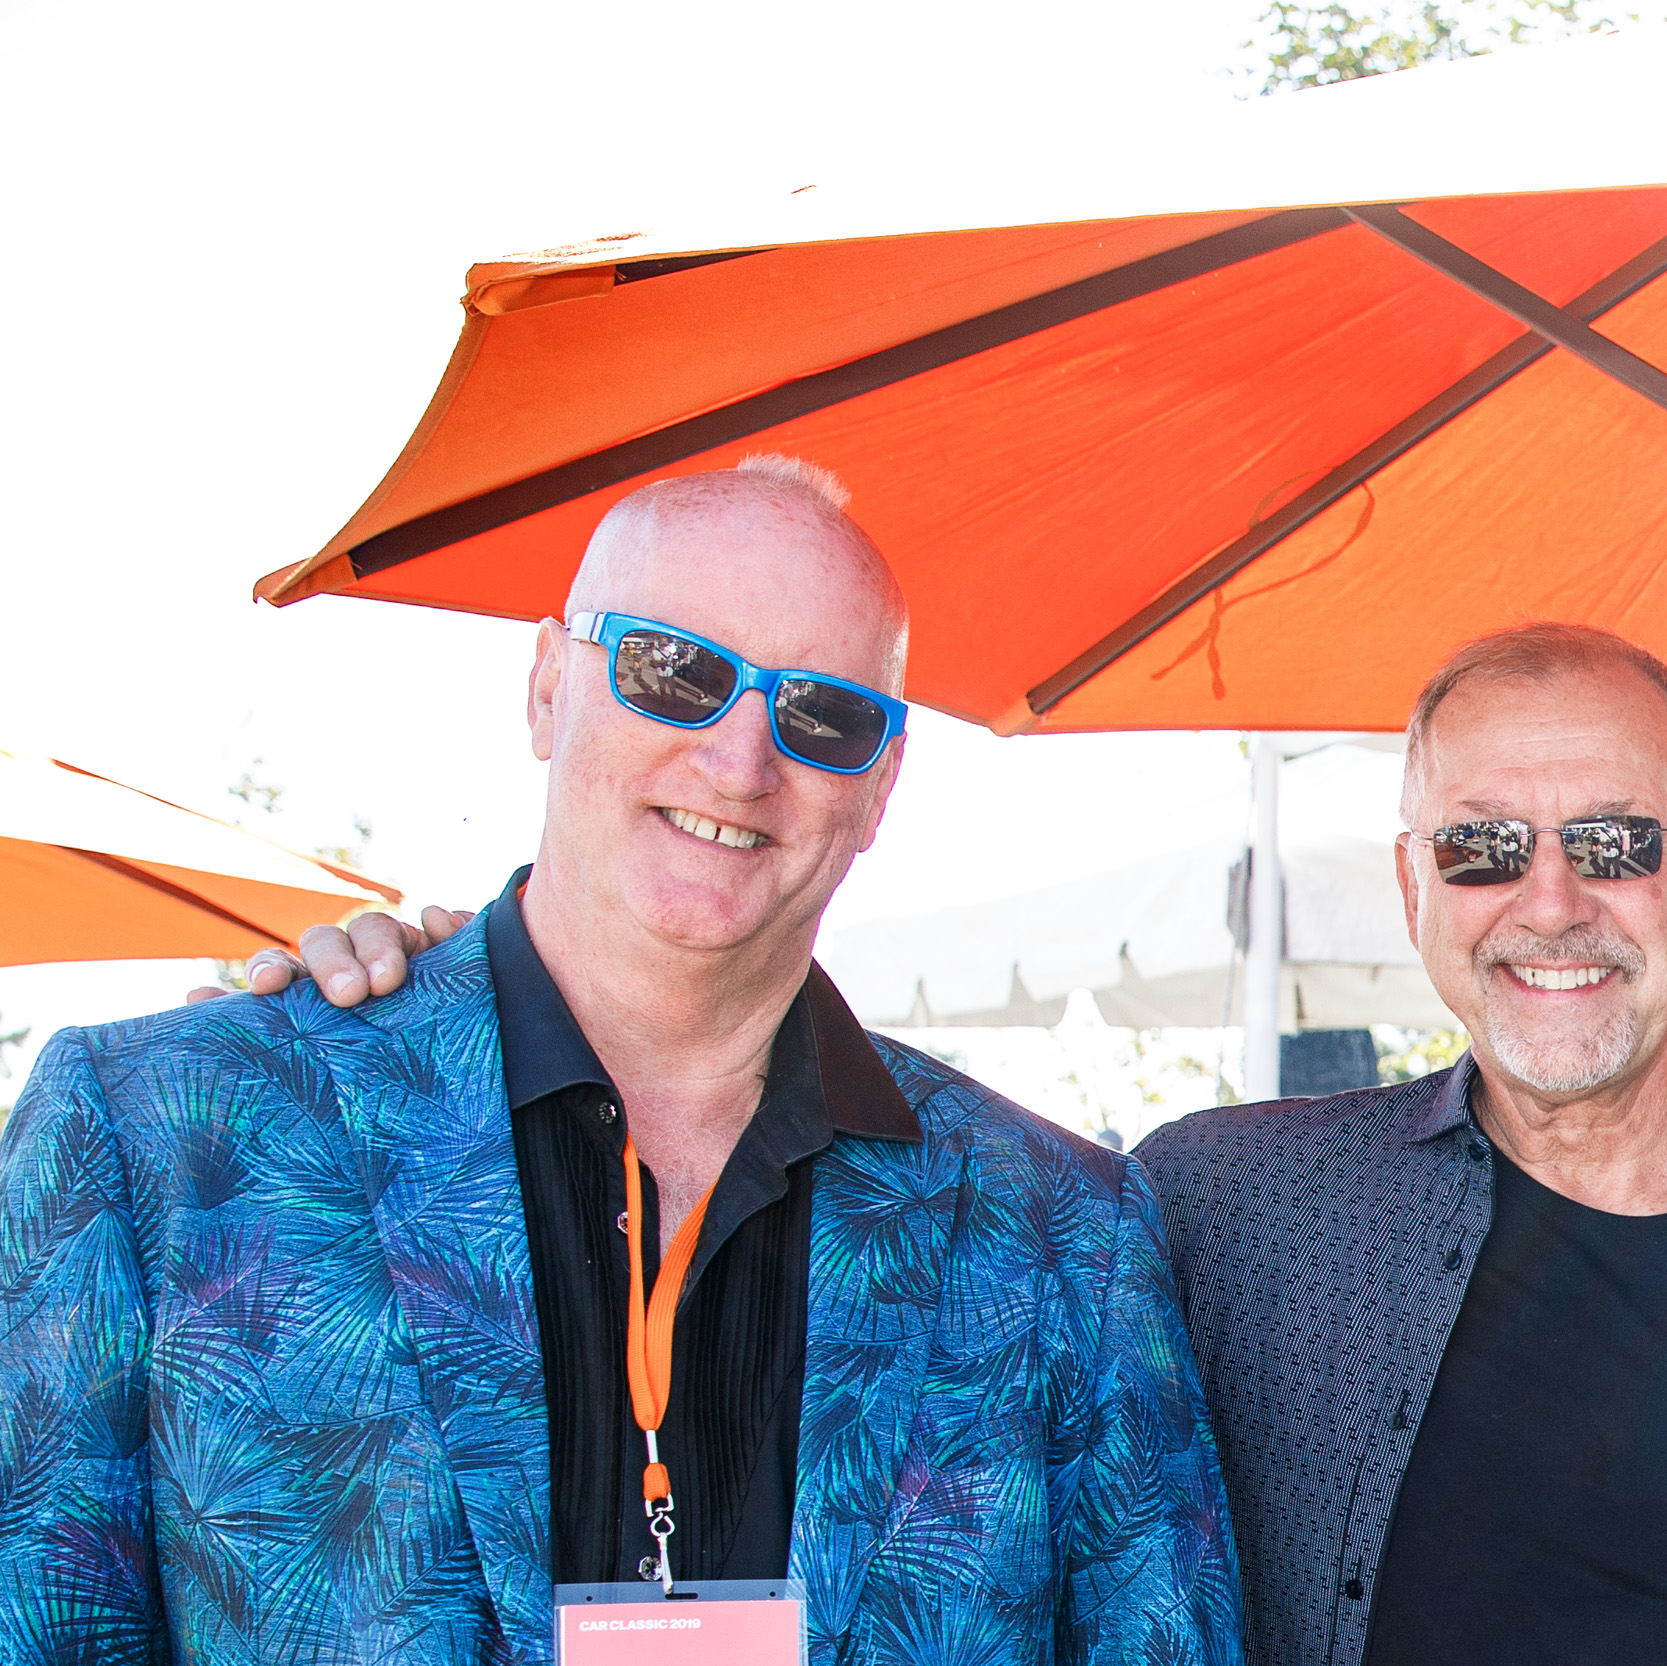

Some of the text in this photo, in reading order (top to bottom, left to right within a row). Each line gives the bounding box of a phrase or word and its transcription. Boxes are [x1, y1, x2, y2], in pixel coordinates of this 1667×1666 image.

[579, 1618, 702, 1632] CAR CLASSIC 2019
